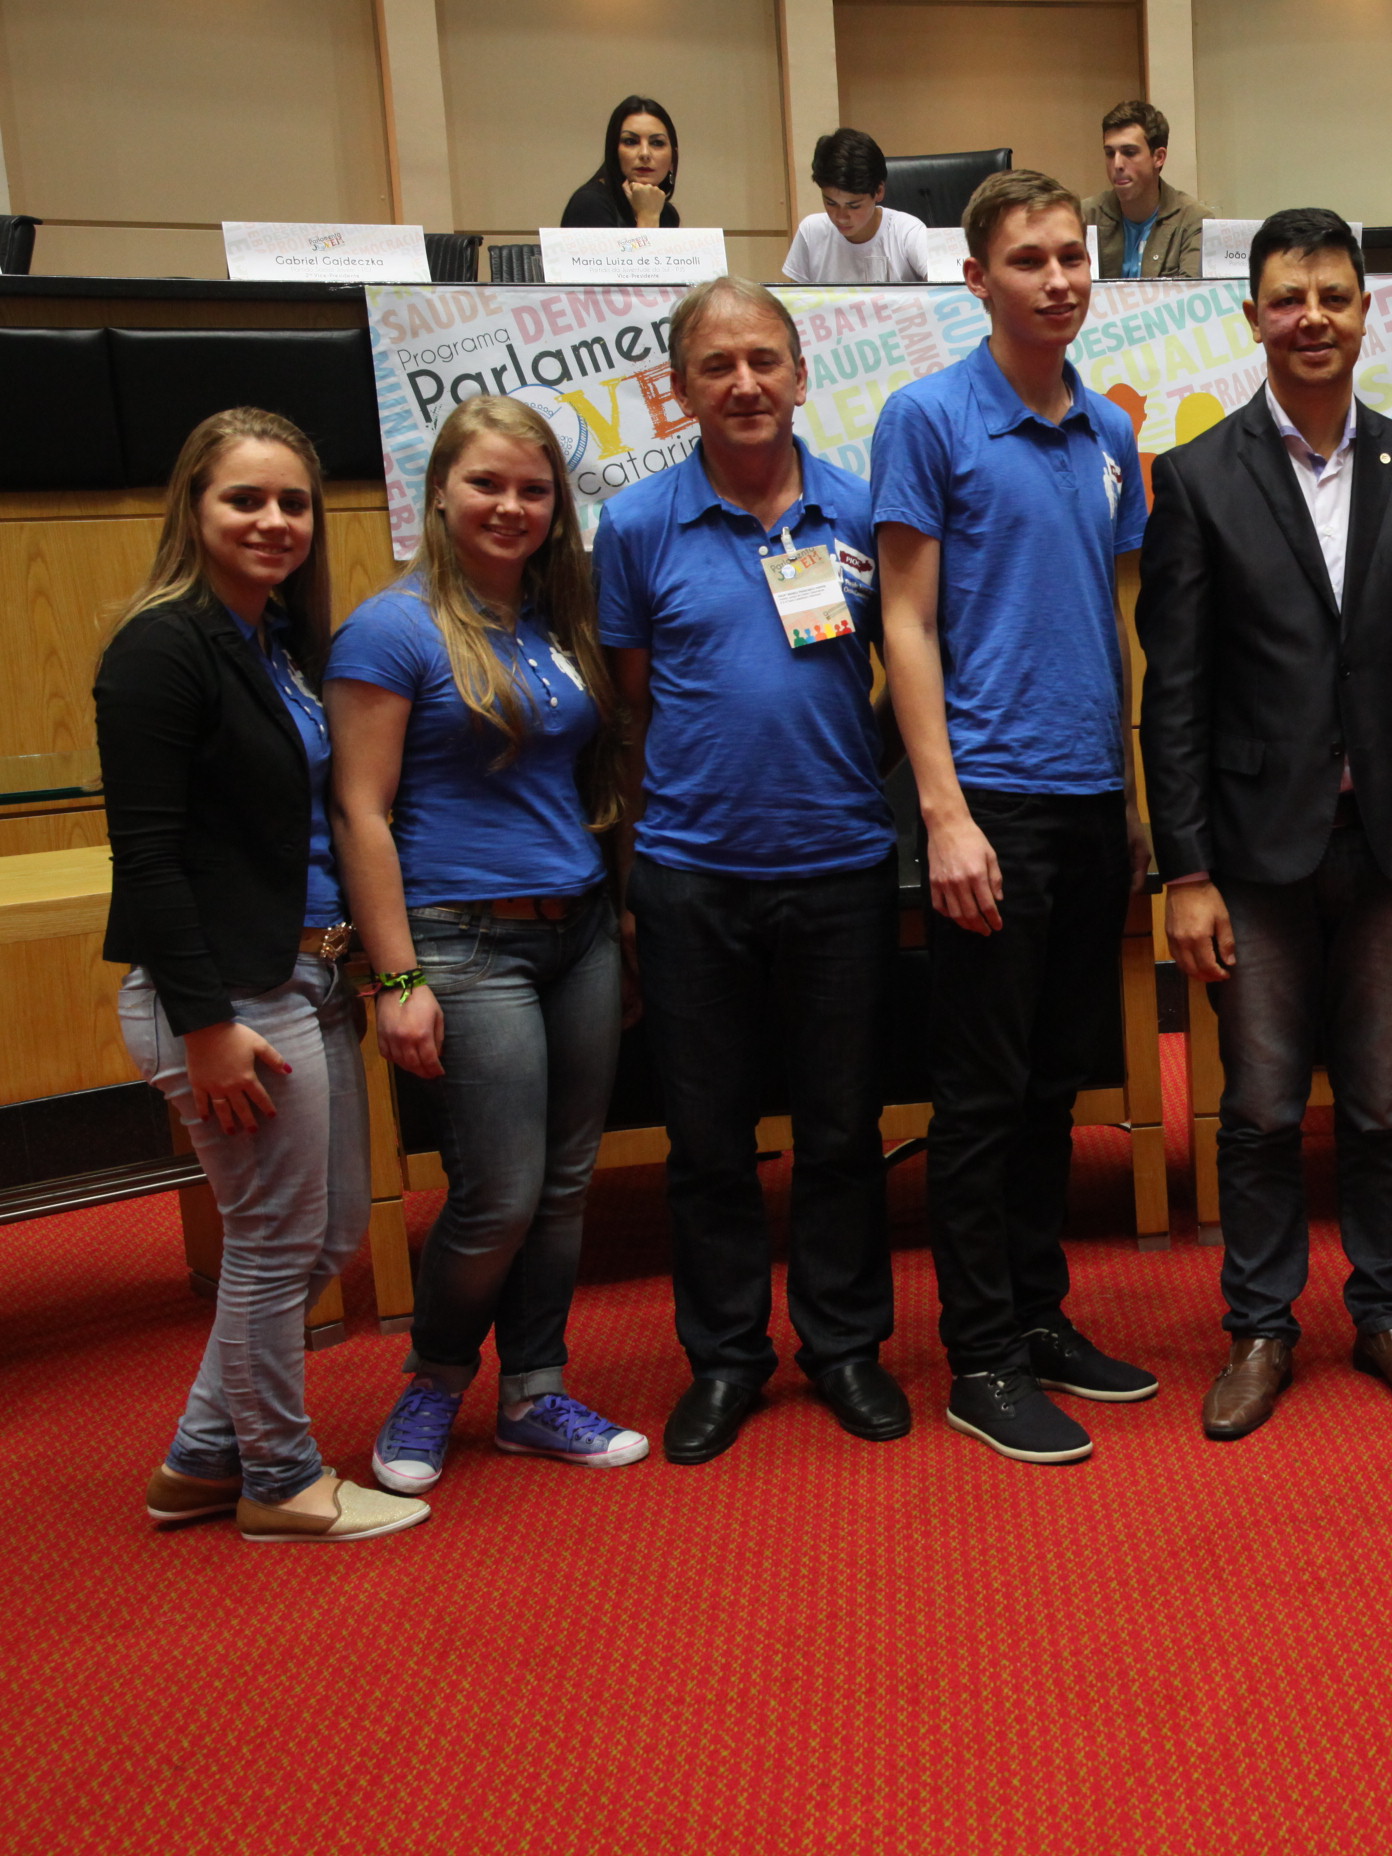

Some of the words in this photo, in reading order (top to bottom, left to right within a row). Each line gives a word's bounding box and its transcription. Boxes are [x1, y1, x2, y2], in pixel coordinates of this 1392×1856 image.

[1224, 250, 1247, 259] João
[275, 256, 318, 265] Gabriel
[322, 256, 384, 267] Gajdeczka
[572, 257, 602, 266] Maria
[606, 257, 633, 266] Luiza
[637, 256, 651, 265] de
[655, 256, 663, 265] S.
[666, 256, 701, 265] Zanolli
[397, 327, 511, 371] Programa
